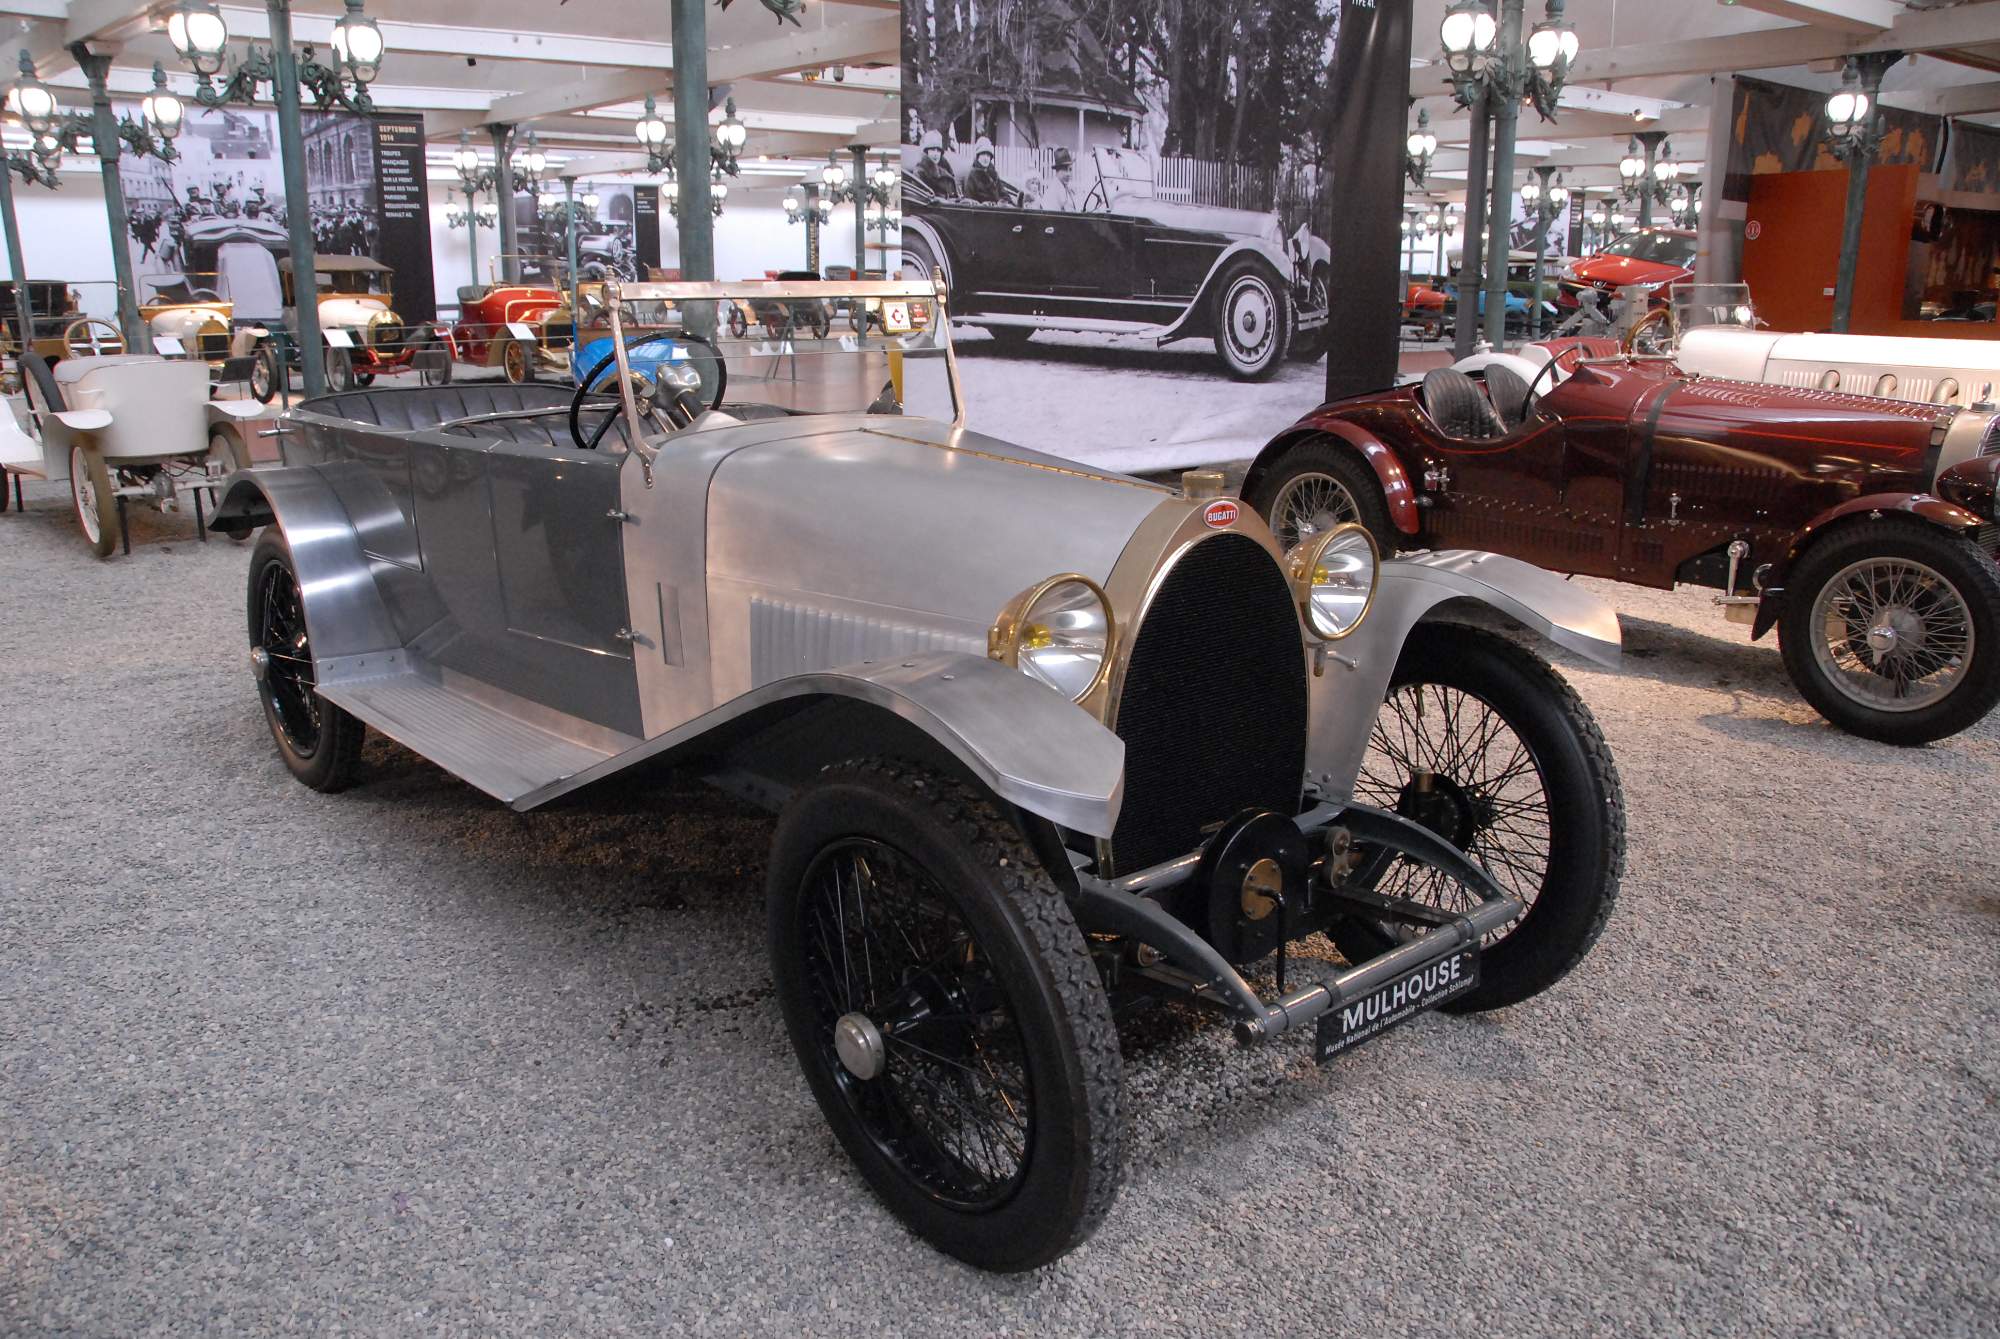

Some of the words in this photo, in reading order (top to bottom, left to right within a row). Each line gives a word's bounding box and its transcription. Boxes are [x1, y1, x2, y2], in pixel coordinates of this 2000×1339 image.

[379, 126, 416, 134] SEPTEMBRE
[1208, 510, 1236, 522] BUGATTI
[1325, 1039, 1345, 1056] Musée
[1346, 1025, 1371, 1045] National
[1371, 1023, 1380, 1032] de
[1421, 988, 1448, 1007] Collection
[1448, 973, 1475, 994] Schlumpf
[1342, 954, 1461, 1034] MULHOUSE
